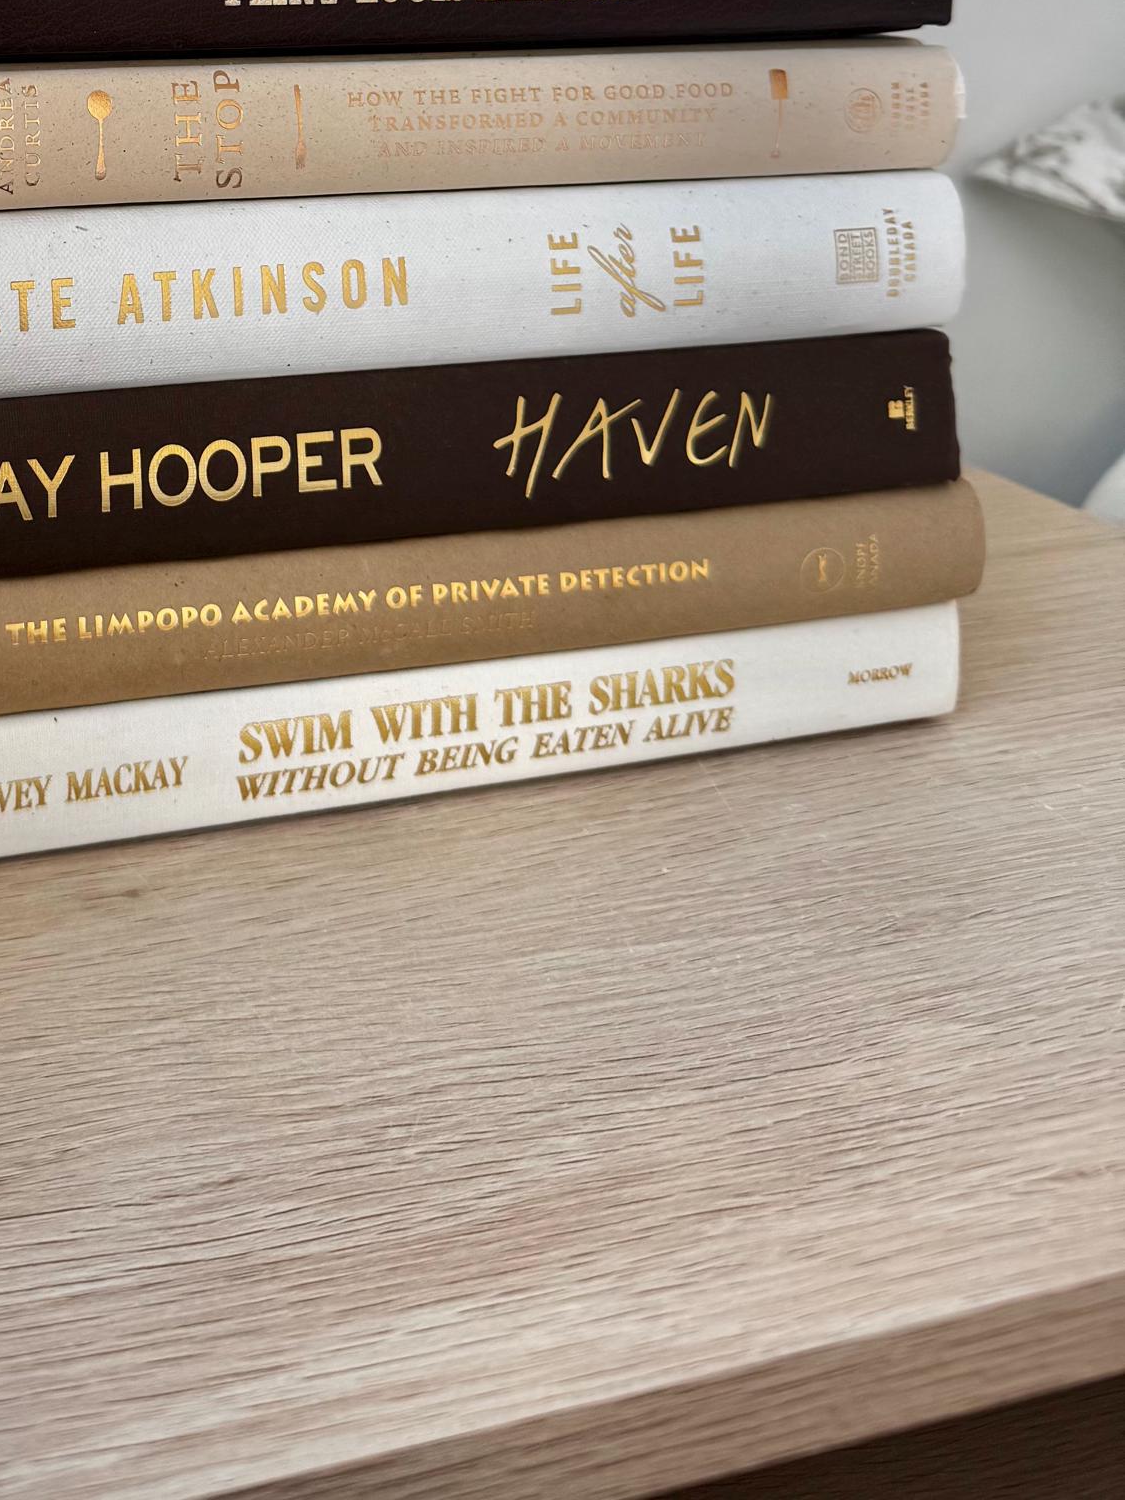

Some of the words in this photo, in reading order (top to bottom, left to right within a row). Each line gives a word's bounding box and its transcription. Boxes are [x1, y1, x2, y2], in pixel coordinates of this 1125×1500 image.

[23, 83, 43, 187] CURTIS
[173, 80, 202, 182] THE
[213, 69, 244, 189] STOP
[347, 90, 403, 108] HOW
[414, 89, 460, 106] THE
[472, 86, 542, 103] FIGHT
[552, 86, 595, 102] FOR
[603, 84, 665, 100] GOOD
[675, 82, 733, 99] FOOD
[368, 112, 543, 133] TRANSFORMED
[553, 111, 566, 126] A
[575, 107, 717, 126] COMMUNITY
[116, 256, 410, 326] ATKINSON
[548, 232, 582, 316] LIFE
[587, 222, 666, 318] after
[670, 224, 705, 307] LIFE
[837, 232, 849, 282] BOND
[850, 234, 862, 281] STREET
[863, 231, 875, 279] BOOKS
[882, 208, 900, 298] DOUBLEDAY
[901, 221, 916, 282] CANADA
[492, 388, 772, 499] HAVEN
[904, 385, 915, 430] BERKLEY
[100, 426, 384, 513] HOOPER
[5, 616, 68, 646] THE
[78, 602, 223, 641] LIMPOPO
[232, 589, 377, 625] ACADEMY
[386, 583, 424, 609] OF
[432, 573, 549, 605] PRIVATE
[559, 558, 710, 595] DETECTION
[238, 708, 355, 766] SWIM
[371, 692, 478, 747] WITH
[494, 680, 573, 727] THE
[588, 658, 736, 716] SHARKS
[847, 662, 913, 685] MORROW
[65, 755, 189, 805] MACKAY
[236, 753, 405, 803] WITHOUT
[414, 734, 518, 777] BEING
[529, 720, 636, 760] EATEN
[645, 706, 735, 743] ALIVE
